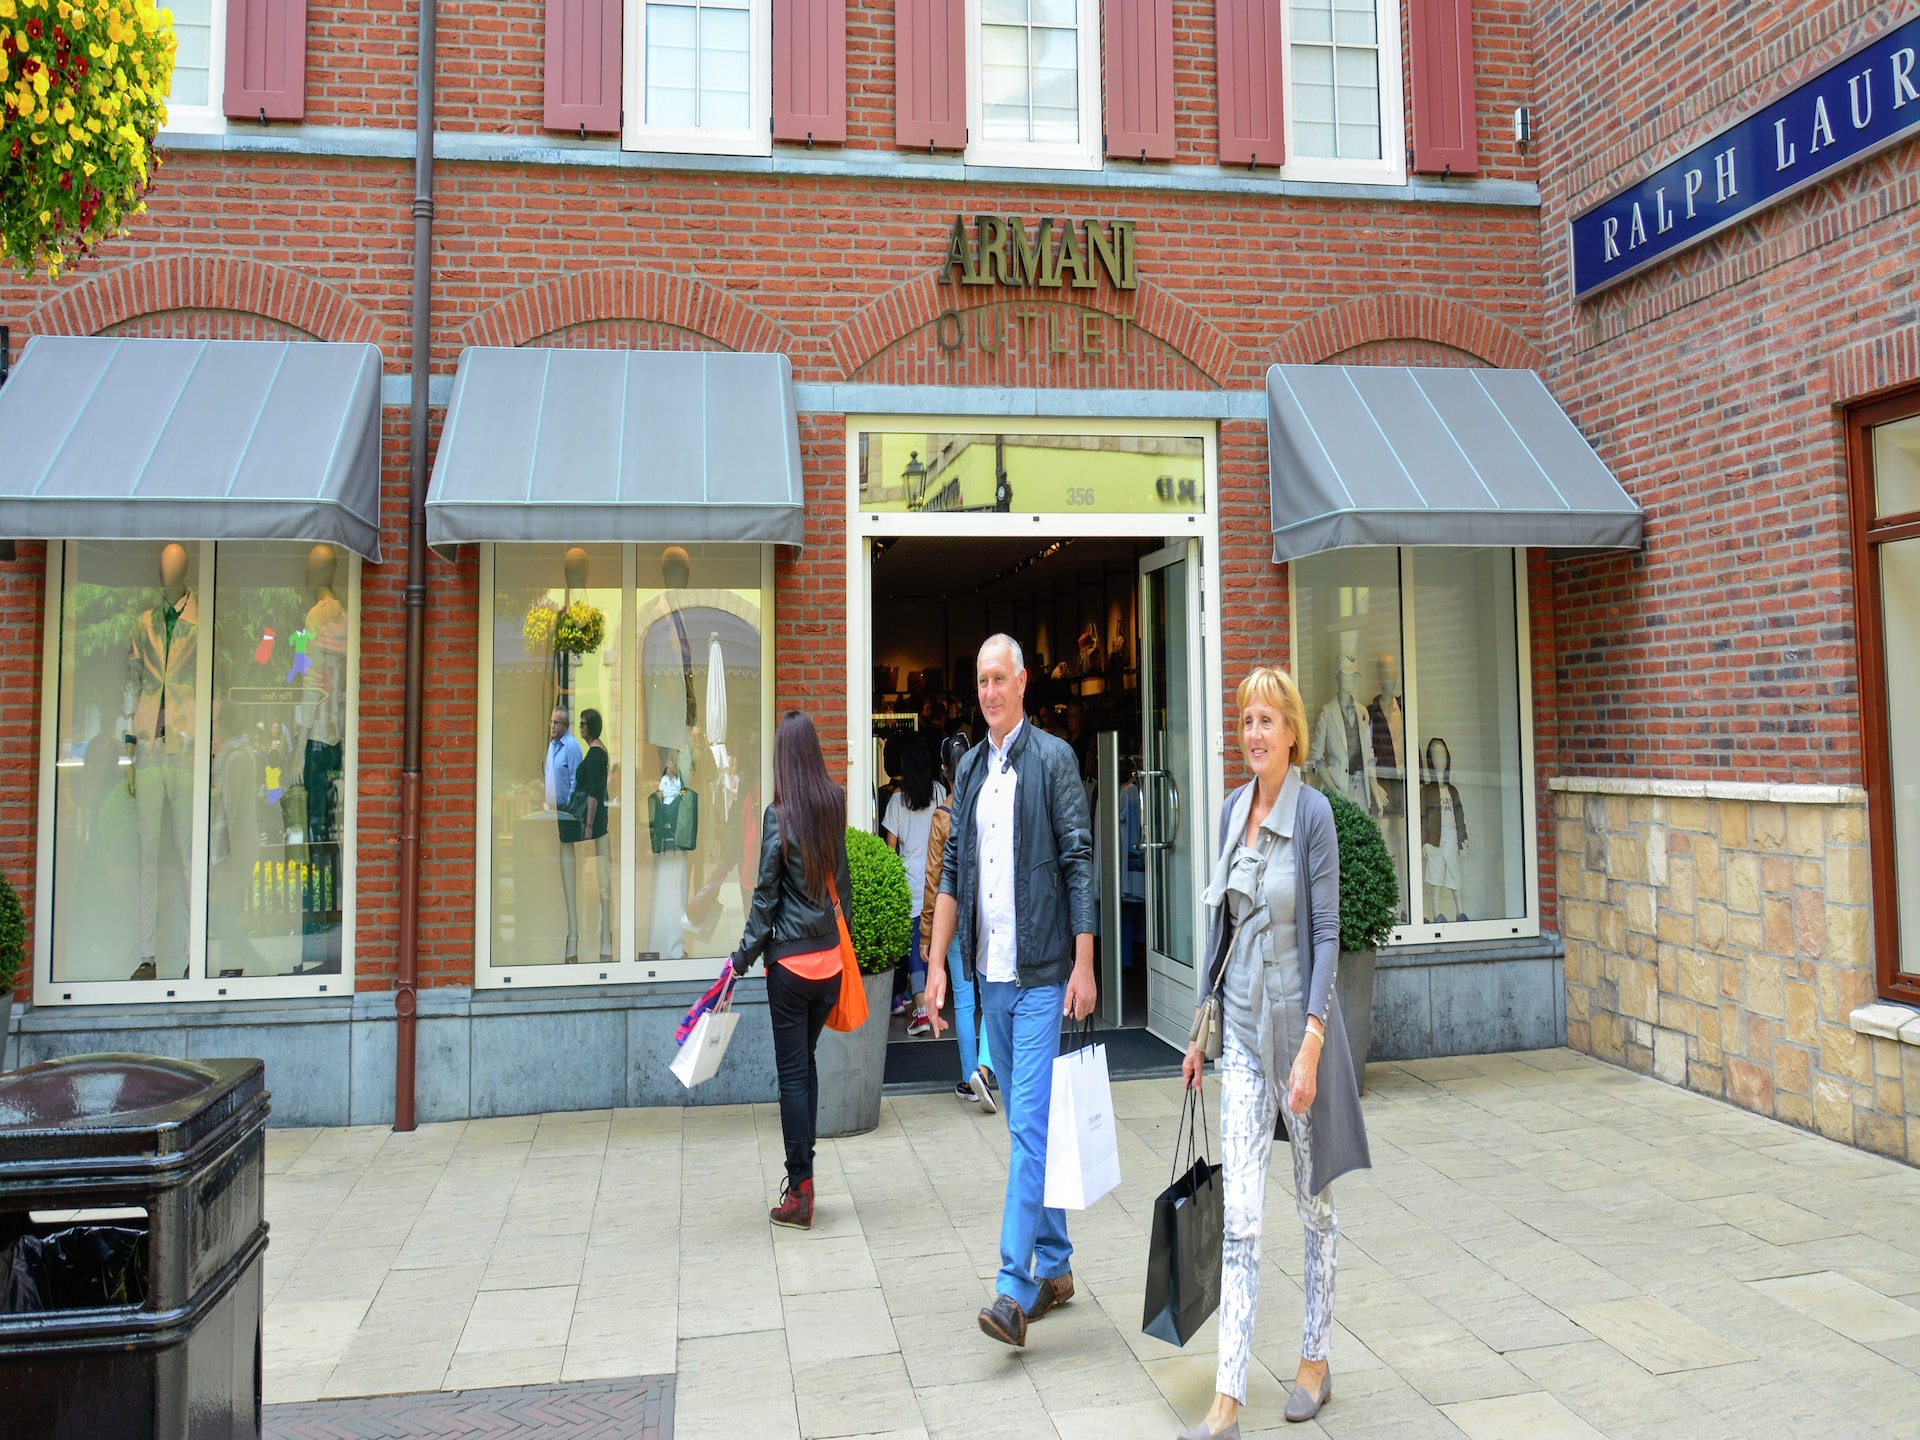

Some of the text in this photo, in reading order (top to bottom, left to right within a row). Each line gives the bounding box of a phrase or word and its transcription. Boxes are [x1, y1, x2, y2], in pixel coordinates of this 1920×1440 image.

[1602, 47, 1920, 264] RALPH LAUR
[938, 214, 1138, 290] ARMANI
[937, 309, 1135, 354] OUTLET
[1066, 487, 1096, 506] 356
